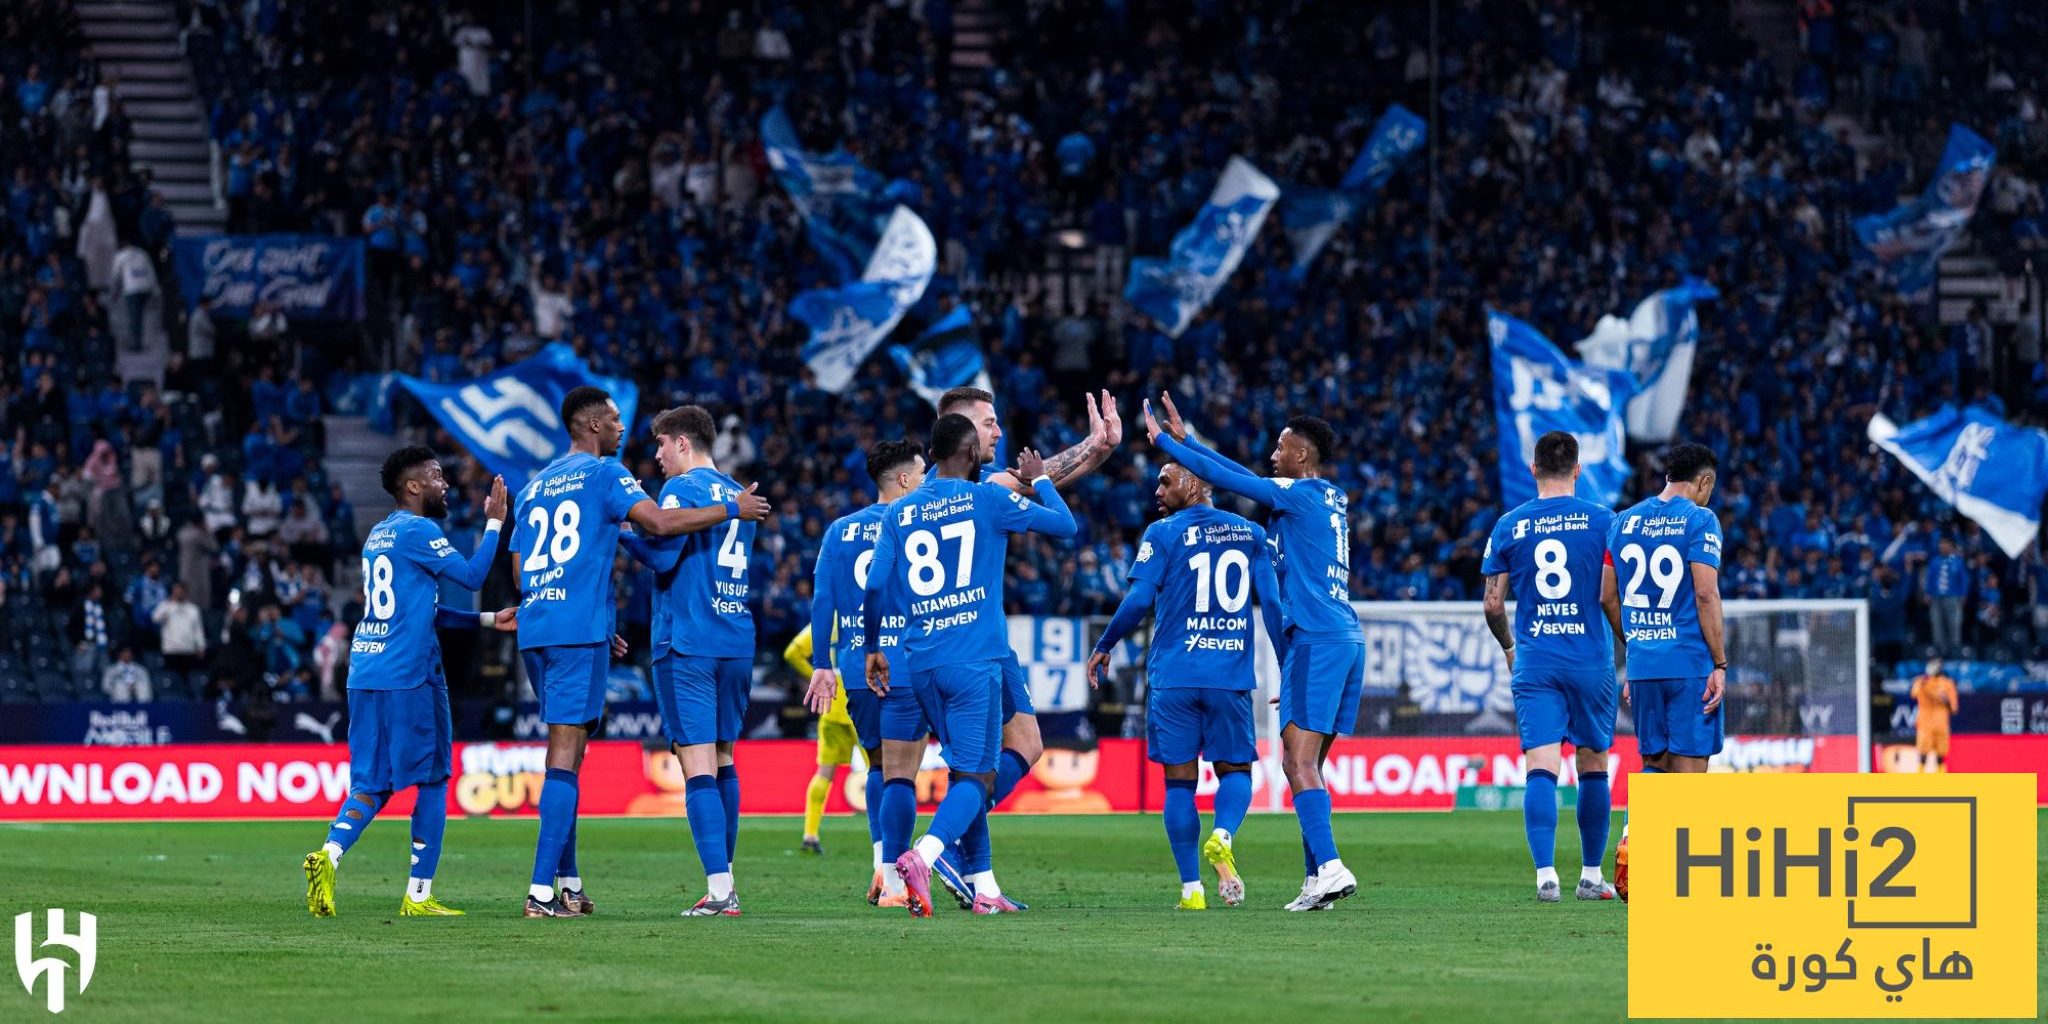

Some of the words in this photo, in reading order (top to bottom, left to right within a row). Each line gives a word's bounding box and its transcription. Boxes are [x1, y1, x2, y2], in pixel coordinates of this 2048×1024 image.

[544, 485, 565, 497] Riyad
[922, 508, 949, 522] Riyad
[950, 502, 974, 515] Bank
[523, 499, 580, 572] 28
[1535, 522, 1562, 534] Riyad
[1564, 521, 1589, 530] Bank
[1641, 527, 1663, 538] Riyad
[1665, 527, 1685, 535] Bank
[1205, 533, 1232, 544] Riyad
[1232, 532, 1254, 542] Bank
[717, 518, 747, 579] 4
[904, 519, 976, 597] 87
[1534, 538, 1572, 600] 8
[1619, 543, 1684, 609] 29
[715, 580, 748, 598] YUSUF
[1188, 549, 1250, 613] 10
[911, 587, 986, 616] ALTAMBAKTI
[1537, 603, 1579, 617] NEVES
[936, 610, 978, 631] SEVEN
[1186, 617, 1247, 630] MALCOM
[1630, 611, 1672, 625] SALEM
[1543, 622, 1585, 635] SEVEN
[1637, 627, 1677, 640] SEVEN
[855, 635, 898, 647] SEN
[1041, 618, 1074, 663] 9
[1197, 637, 1244, 651] SEVEN
[1047, 667, 1068, 706] 7
[237, 761, 351, 804] NOW
